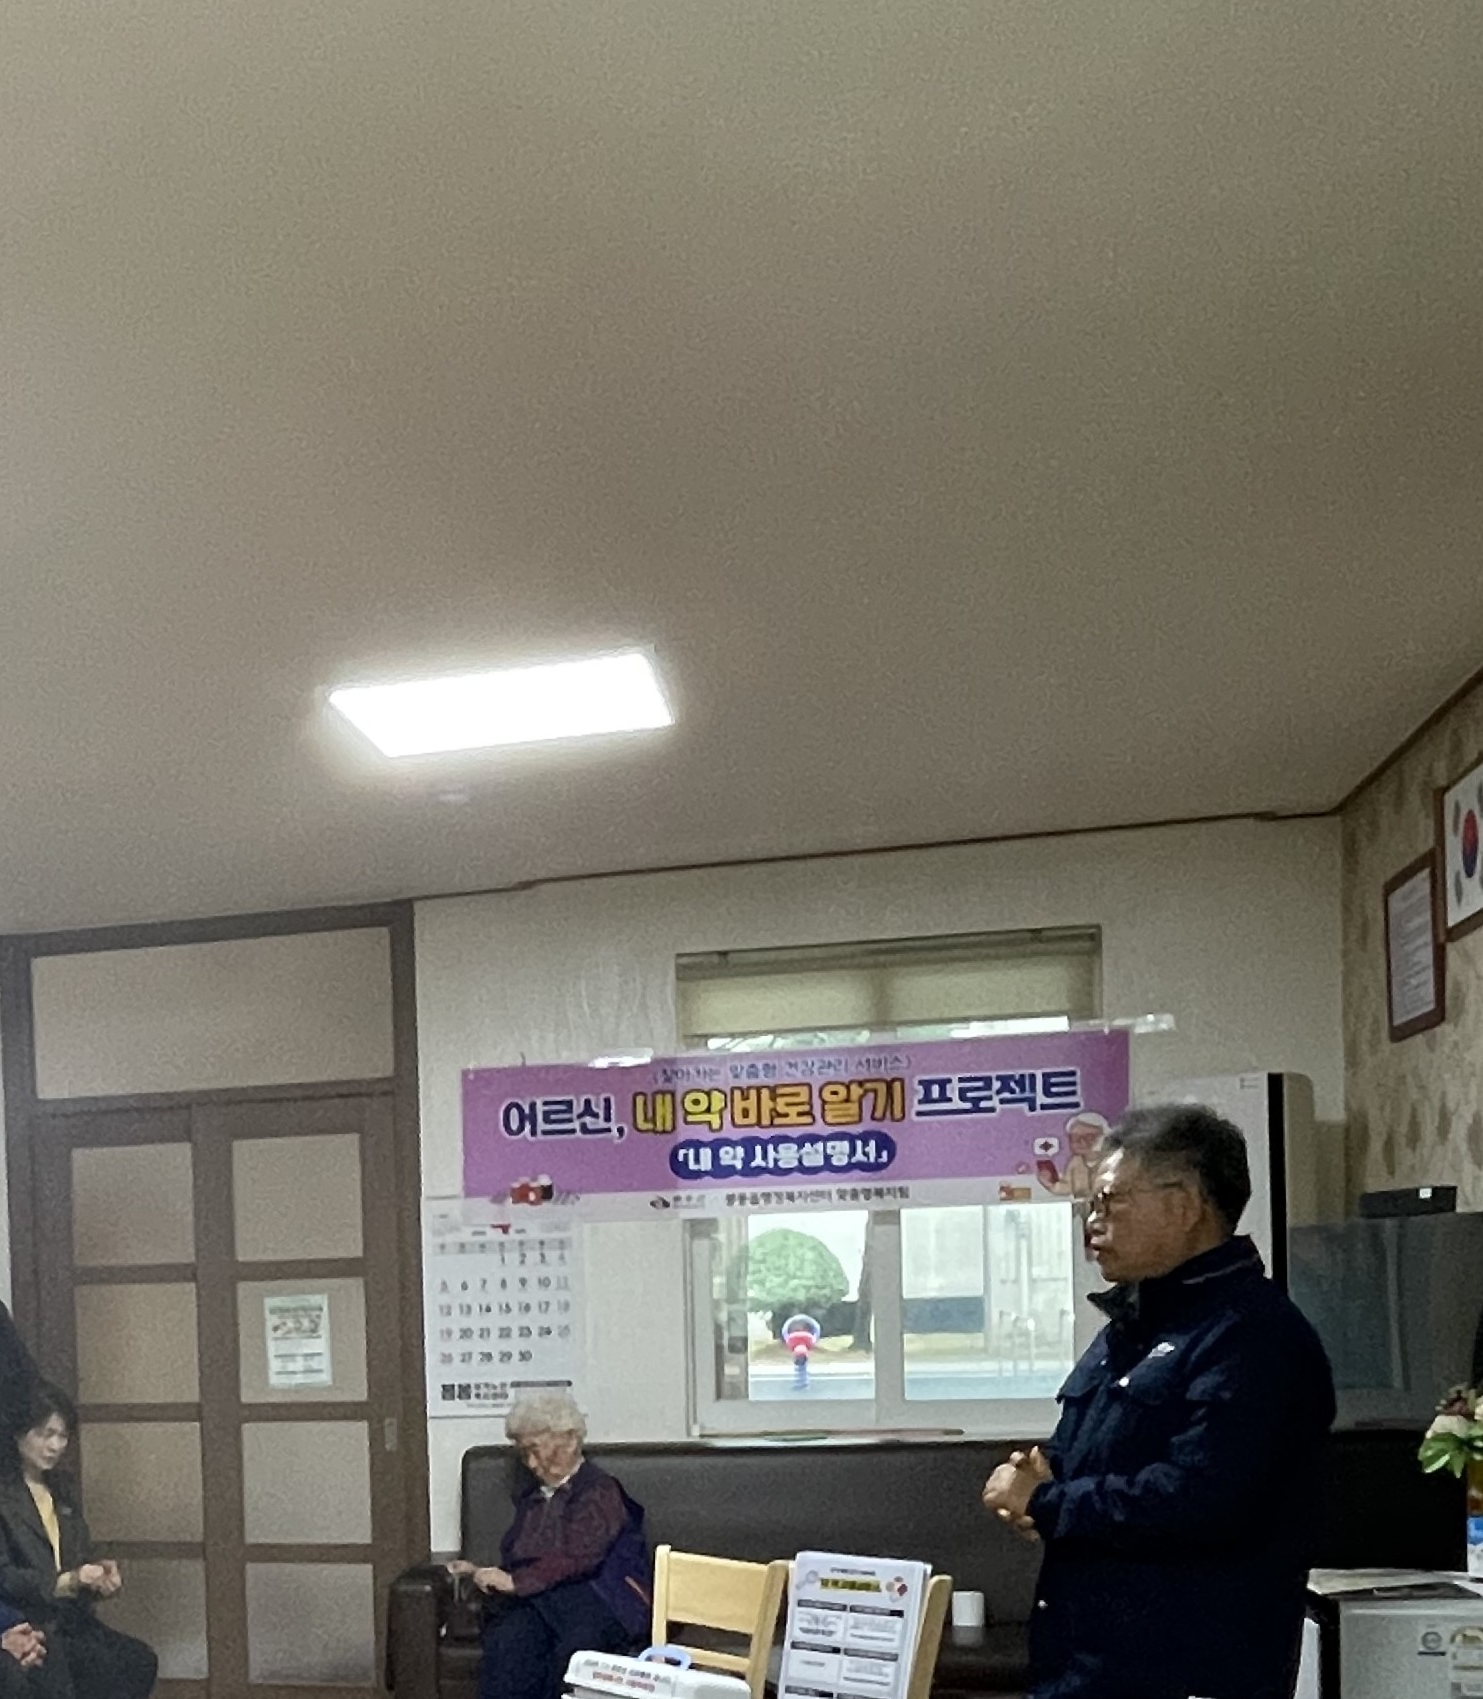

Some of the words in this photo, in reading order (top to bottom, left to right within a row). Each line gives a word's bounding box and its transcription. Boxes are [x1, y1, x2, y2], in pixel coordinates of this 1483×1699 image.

[784, 1058, 849, 1077] 건강관리
[854, 1054, 912, 1073] 서비스)
[501, 1095, 626, 1140] 어르신,
[632, 1090, 675, 1133] 내
[682, 1088, 727, 1131] 약
[730, 1082, 815, 1128] 바로
[819, 1077, 907, 1126] 알기
[914, 1068, 1082, 1119] 프로젝트
[719, 1145, 745, 1170] 약
